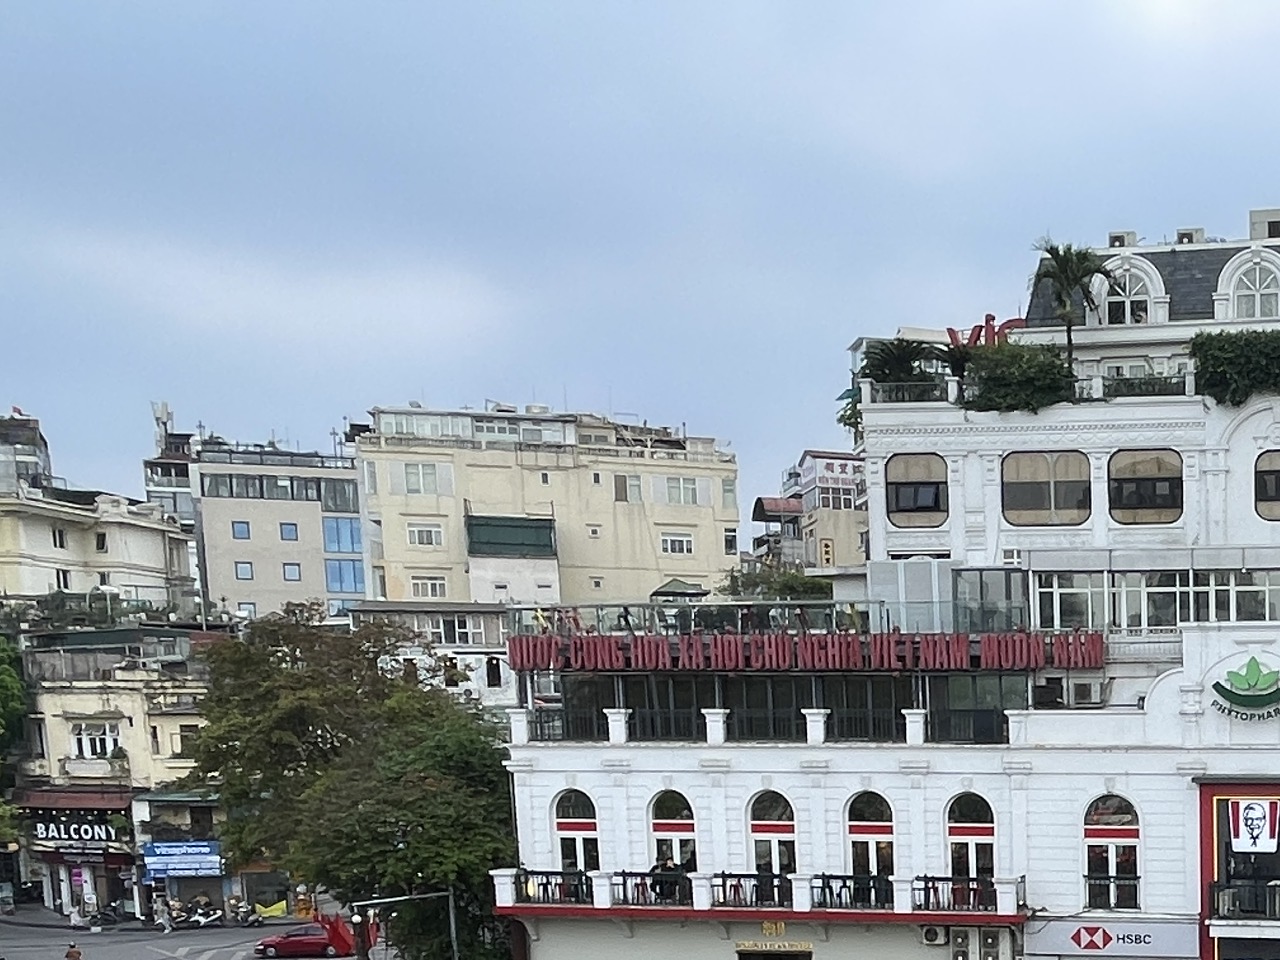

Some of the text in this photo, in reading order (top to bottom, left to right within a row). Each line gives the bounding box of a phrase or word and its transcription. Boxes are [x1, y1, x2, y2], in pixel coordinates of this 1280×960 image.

[919, 632, 971, 669] NAM
[36, 823, 117, 840] BALCONY
[1116, 934, 1152, 945] HSBC
